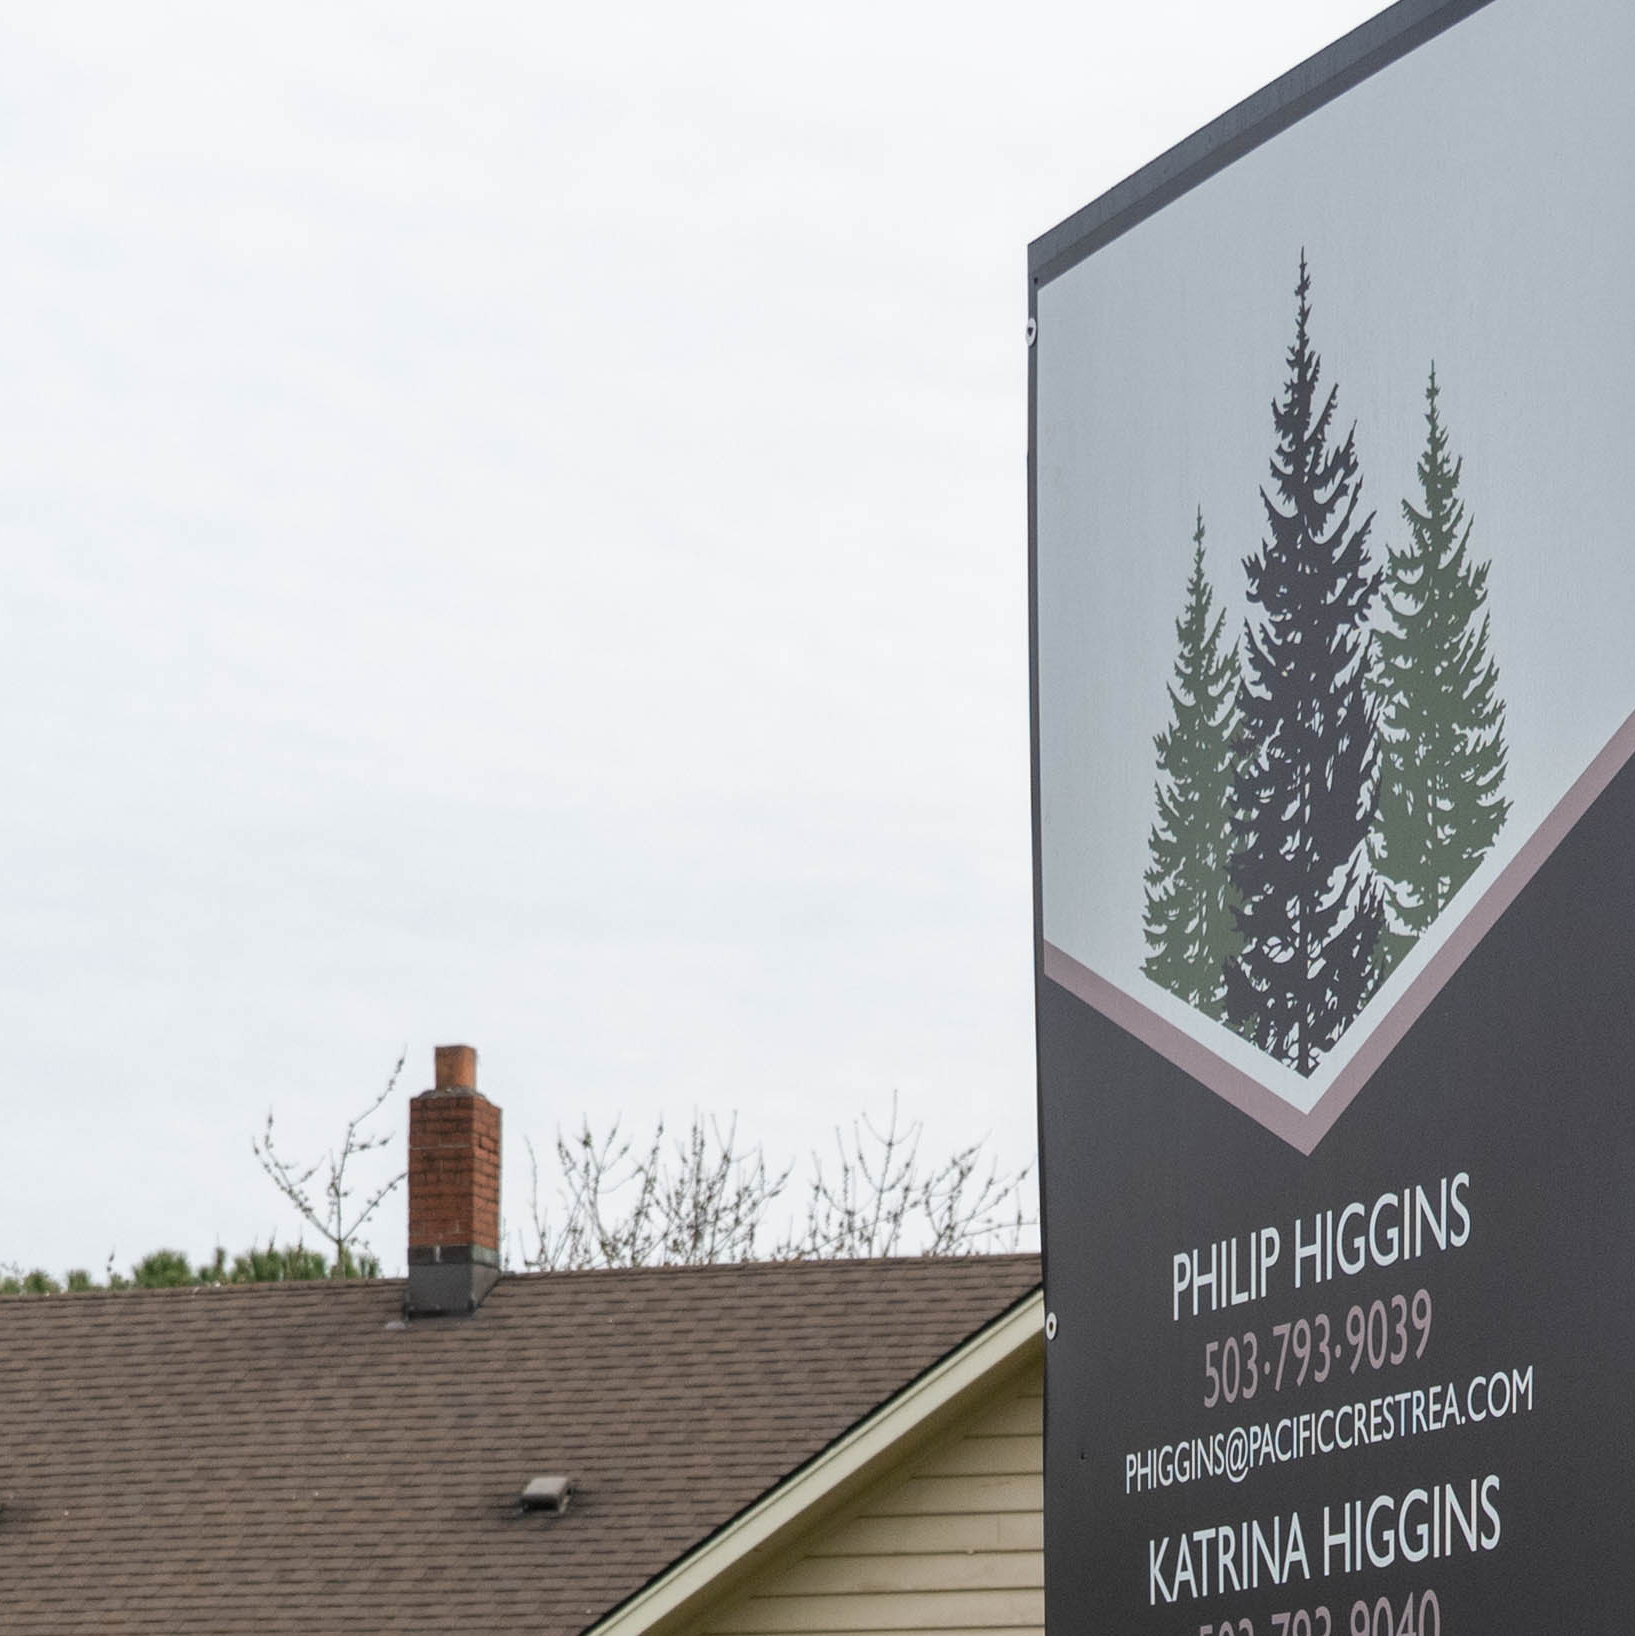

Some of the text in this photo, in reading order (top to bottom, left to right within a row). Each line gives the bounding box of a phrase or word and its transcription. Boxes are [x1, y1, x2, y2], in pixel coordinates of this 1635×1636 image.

[1174, 1172, 1470, 1321] PHILIP HIGGINS
[1126, 1366, 1533, 1494] PHIGGINS@PACIFICCRESTREA.COM
[1150, 1475, 1500, 1605] KATRINA HIGGINS
